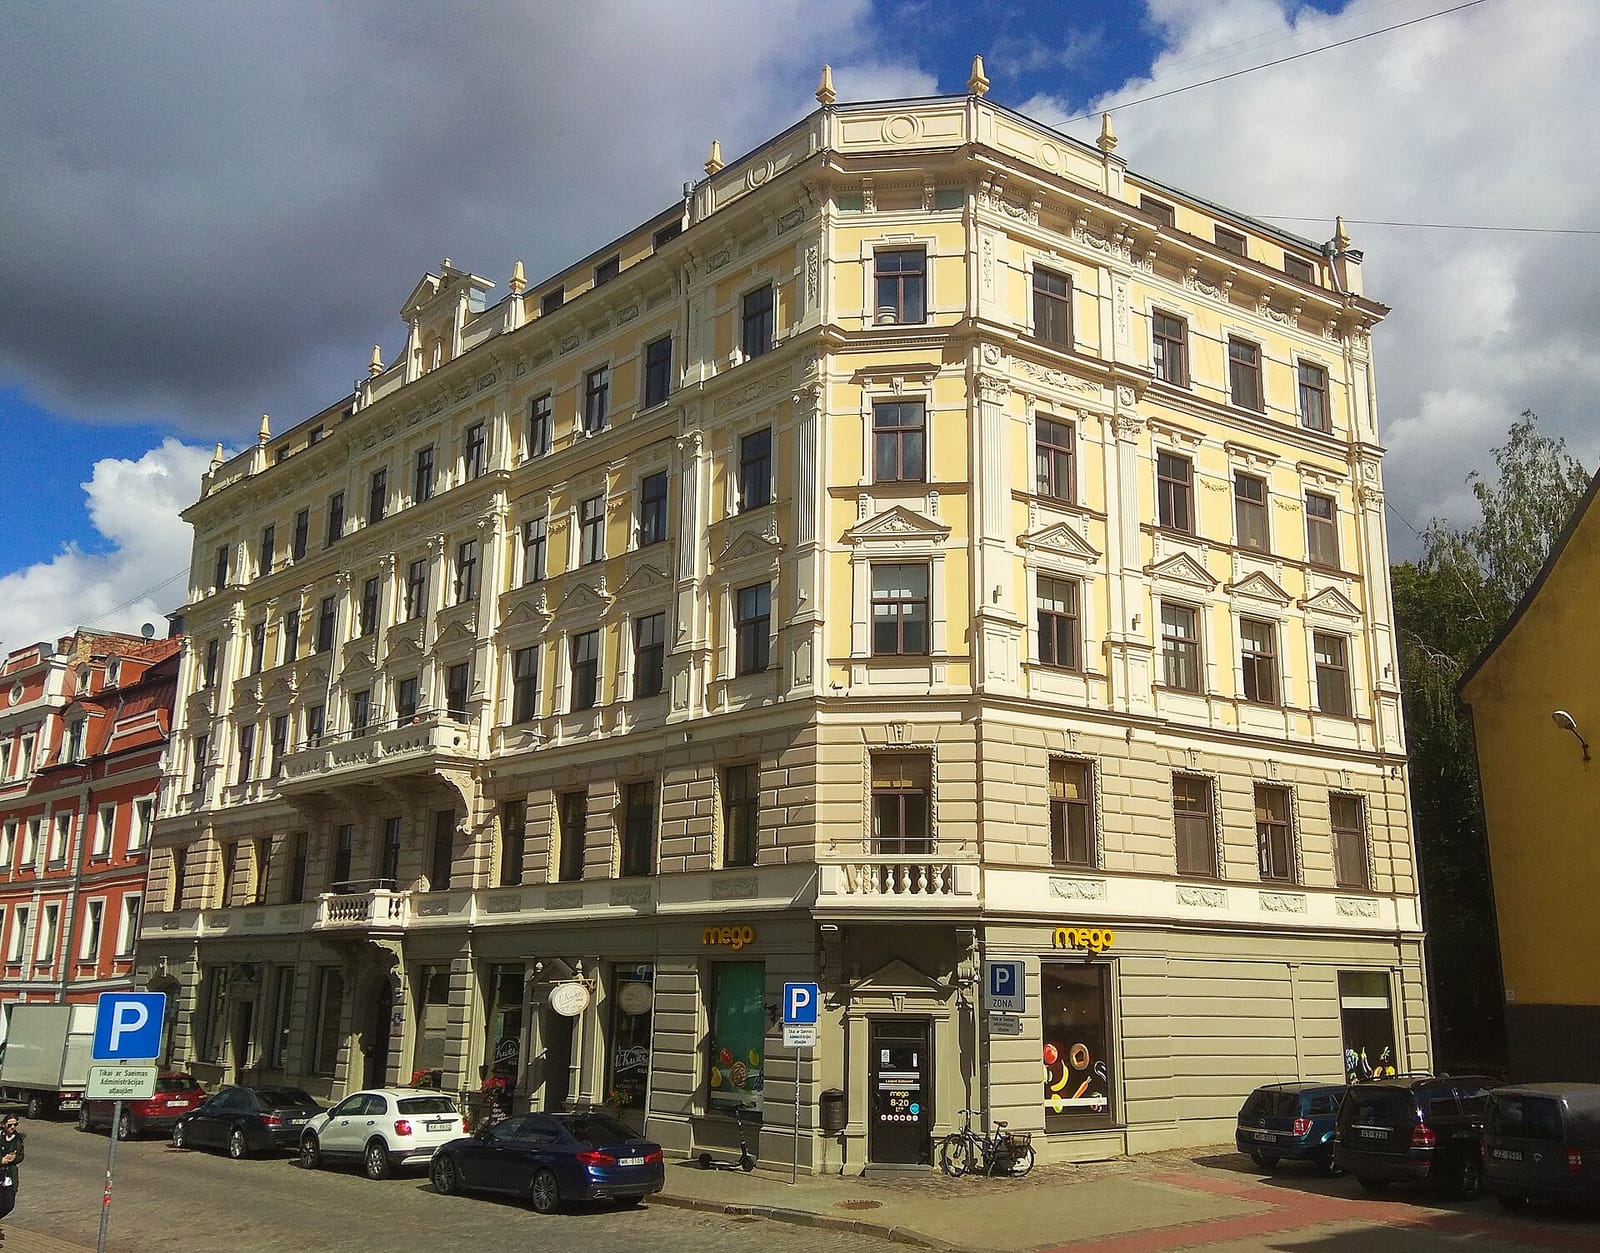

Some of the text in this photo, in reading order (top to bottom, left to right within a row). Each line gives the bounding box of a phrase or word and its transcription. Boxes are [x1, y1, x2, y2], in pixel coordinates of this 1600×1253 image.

[703, 926, 754, 950] mego
[1054, 927, 1113, 952] mego
[996, 967, 1010, 992] P
[791, 988, 810, 1019] P
[992, 998, 1014, 1008] ZONA
[109, 1001, 149, 1051] P
[99, 1069, 113, 1077] Tikai
[124, 1069, 148, 1077] Saeimas
[889, 1090, 910, 1098] mego
[890, 1098, 909, 1107] 8-20
